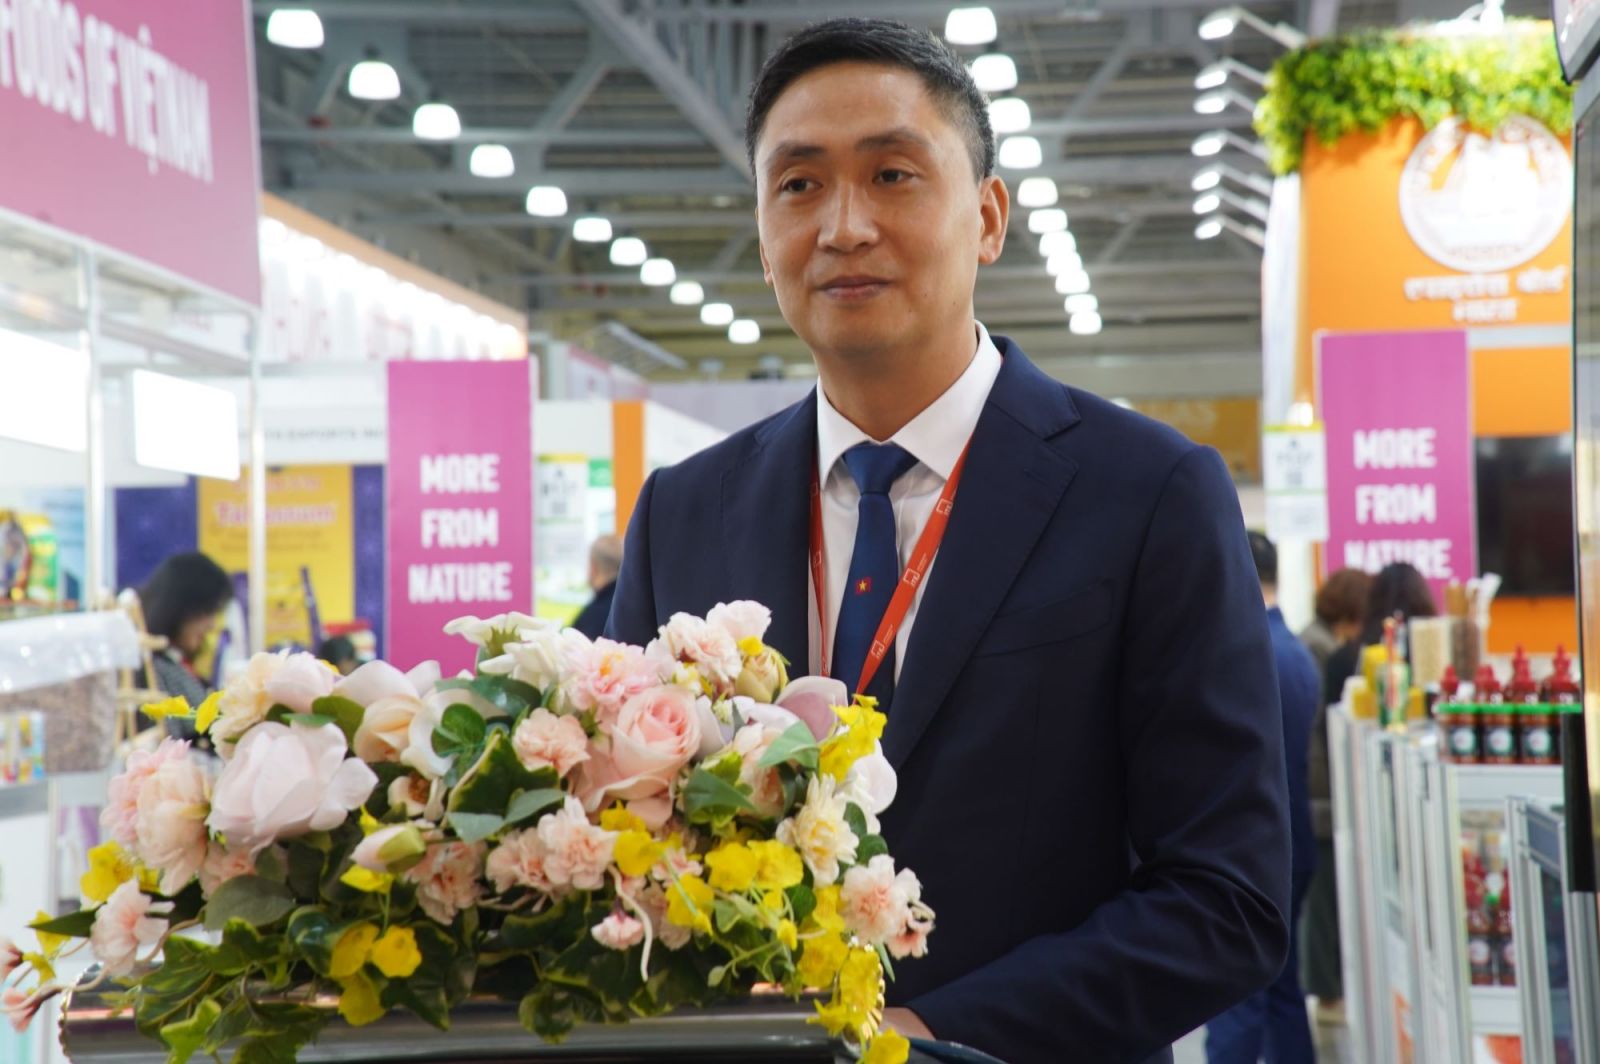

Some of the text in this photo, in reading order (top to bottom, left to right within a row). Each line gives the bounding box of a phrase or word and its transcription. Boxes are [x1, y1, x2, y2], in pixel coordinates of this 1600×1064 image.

[83, 14, 117, 138] OF
[1352, 427, 1437, 470] MORE
[419, 453, 501, 495] MORE
[1355, 482, 1437, 525] FROM
[420, 507, 499, 549] FROM
[408, 561, 513, 604] NATURE
